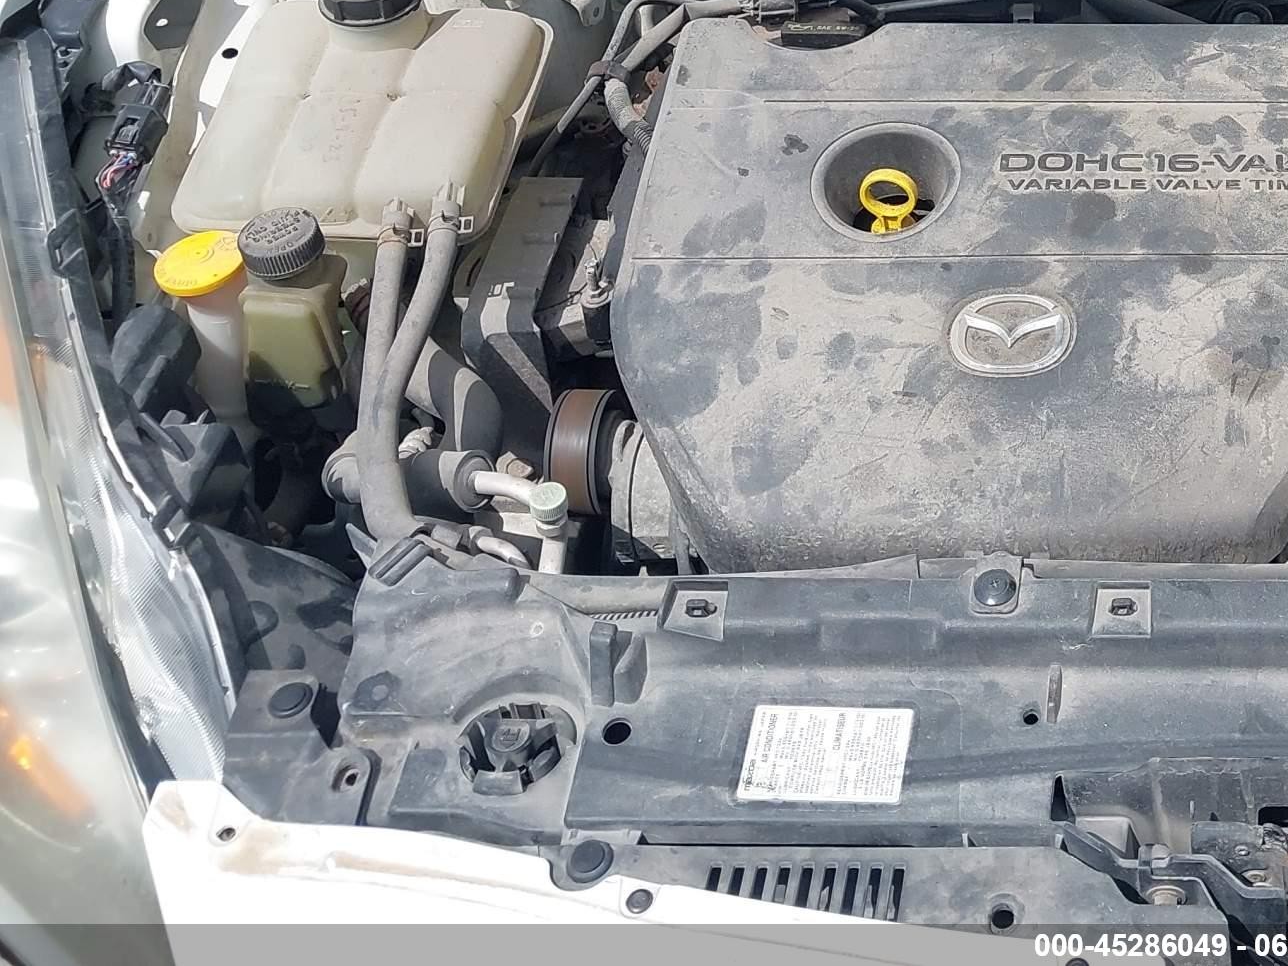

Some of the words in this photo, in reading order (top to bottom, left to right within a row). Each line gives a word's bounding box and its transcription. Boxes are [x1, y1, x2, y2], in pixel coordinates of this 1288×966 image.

[1000, 153, 1144, 172] DOHC
[1007, 178, 1148, 191] VARIABLE
[1156, 178, 1242, 191] VALVE
[763, 713, 778, 752] CONDITIONER
[832, 712, 847, 751] CLIMATISEUR
